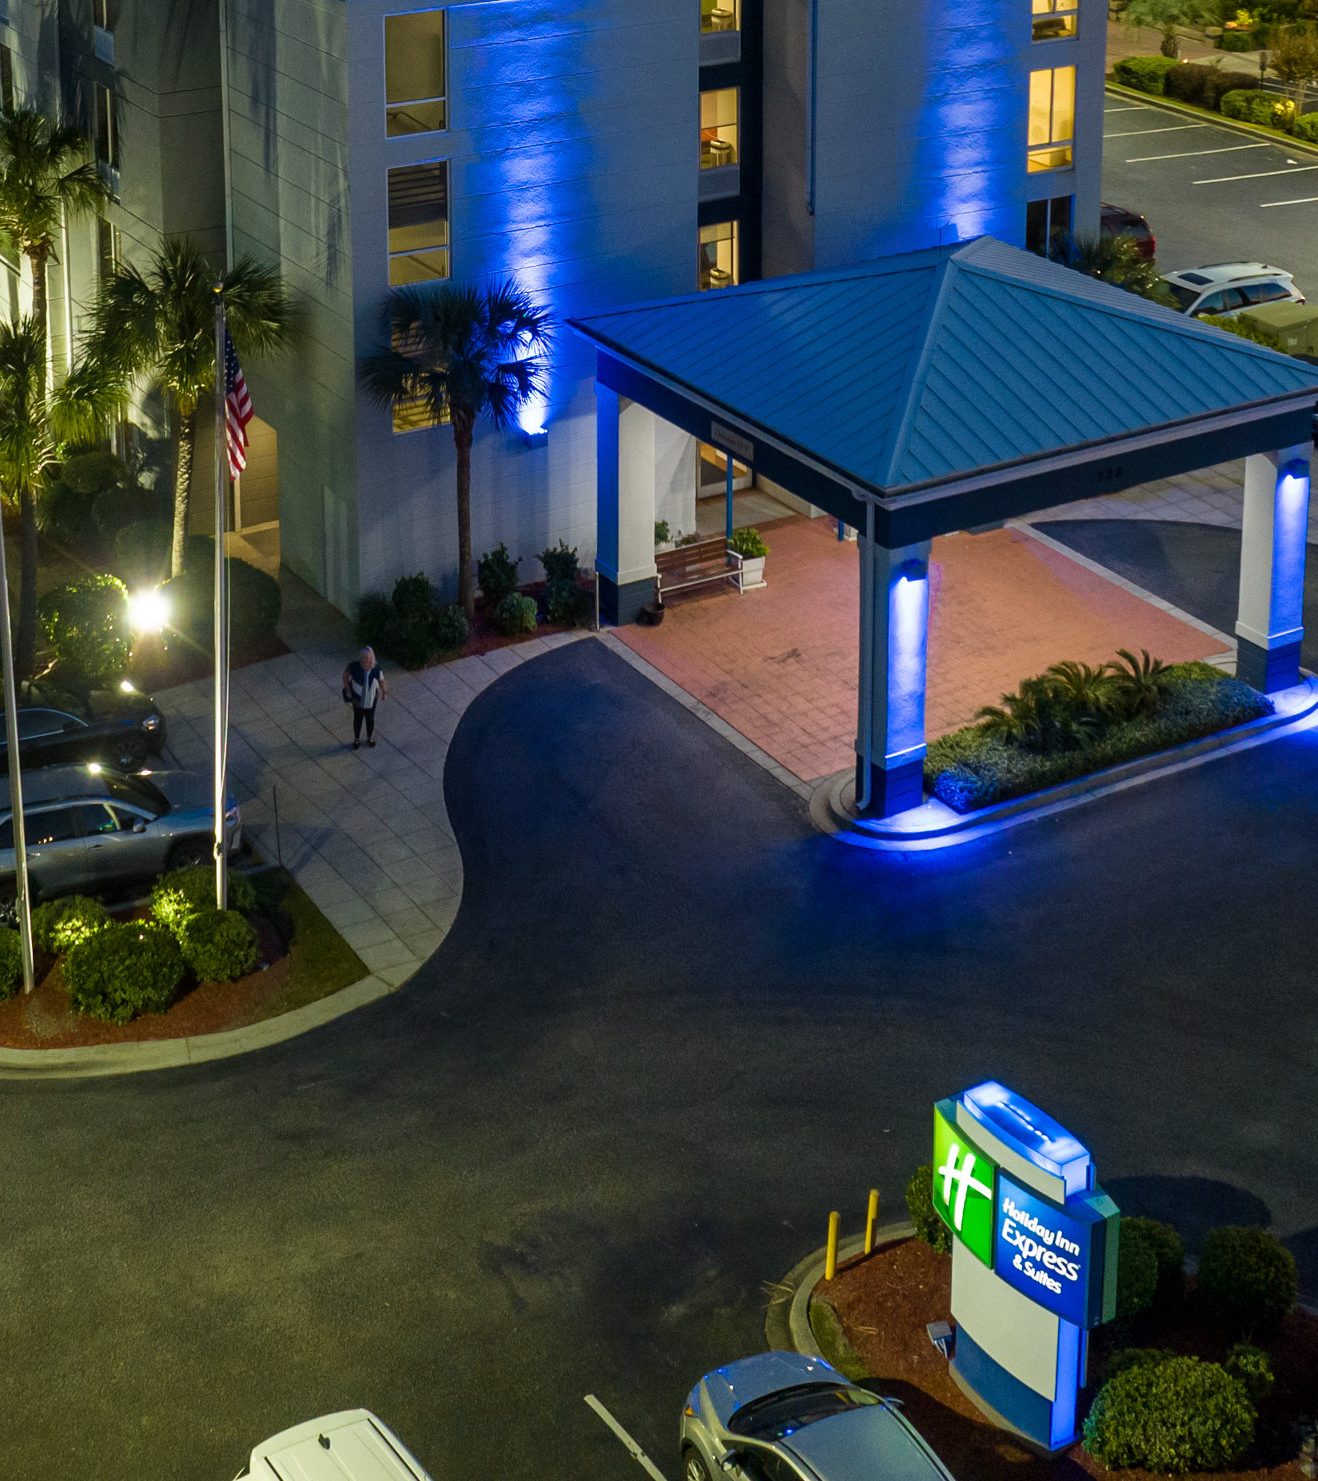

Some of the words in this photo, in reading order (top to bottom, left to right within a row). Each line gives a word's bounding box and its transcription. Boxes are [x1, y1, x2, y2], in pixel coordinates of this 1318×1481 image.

[1002, 1197, 1055, 1245] Holiday
[1055, 1230, 1080, 1256] Inn
[1002, 1217, 1079, 1281] Express
[1012, 1254, 1023, 1271] &
[1023, 1261, 1062, 1294] Suites
